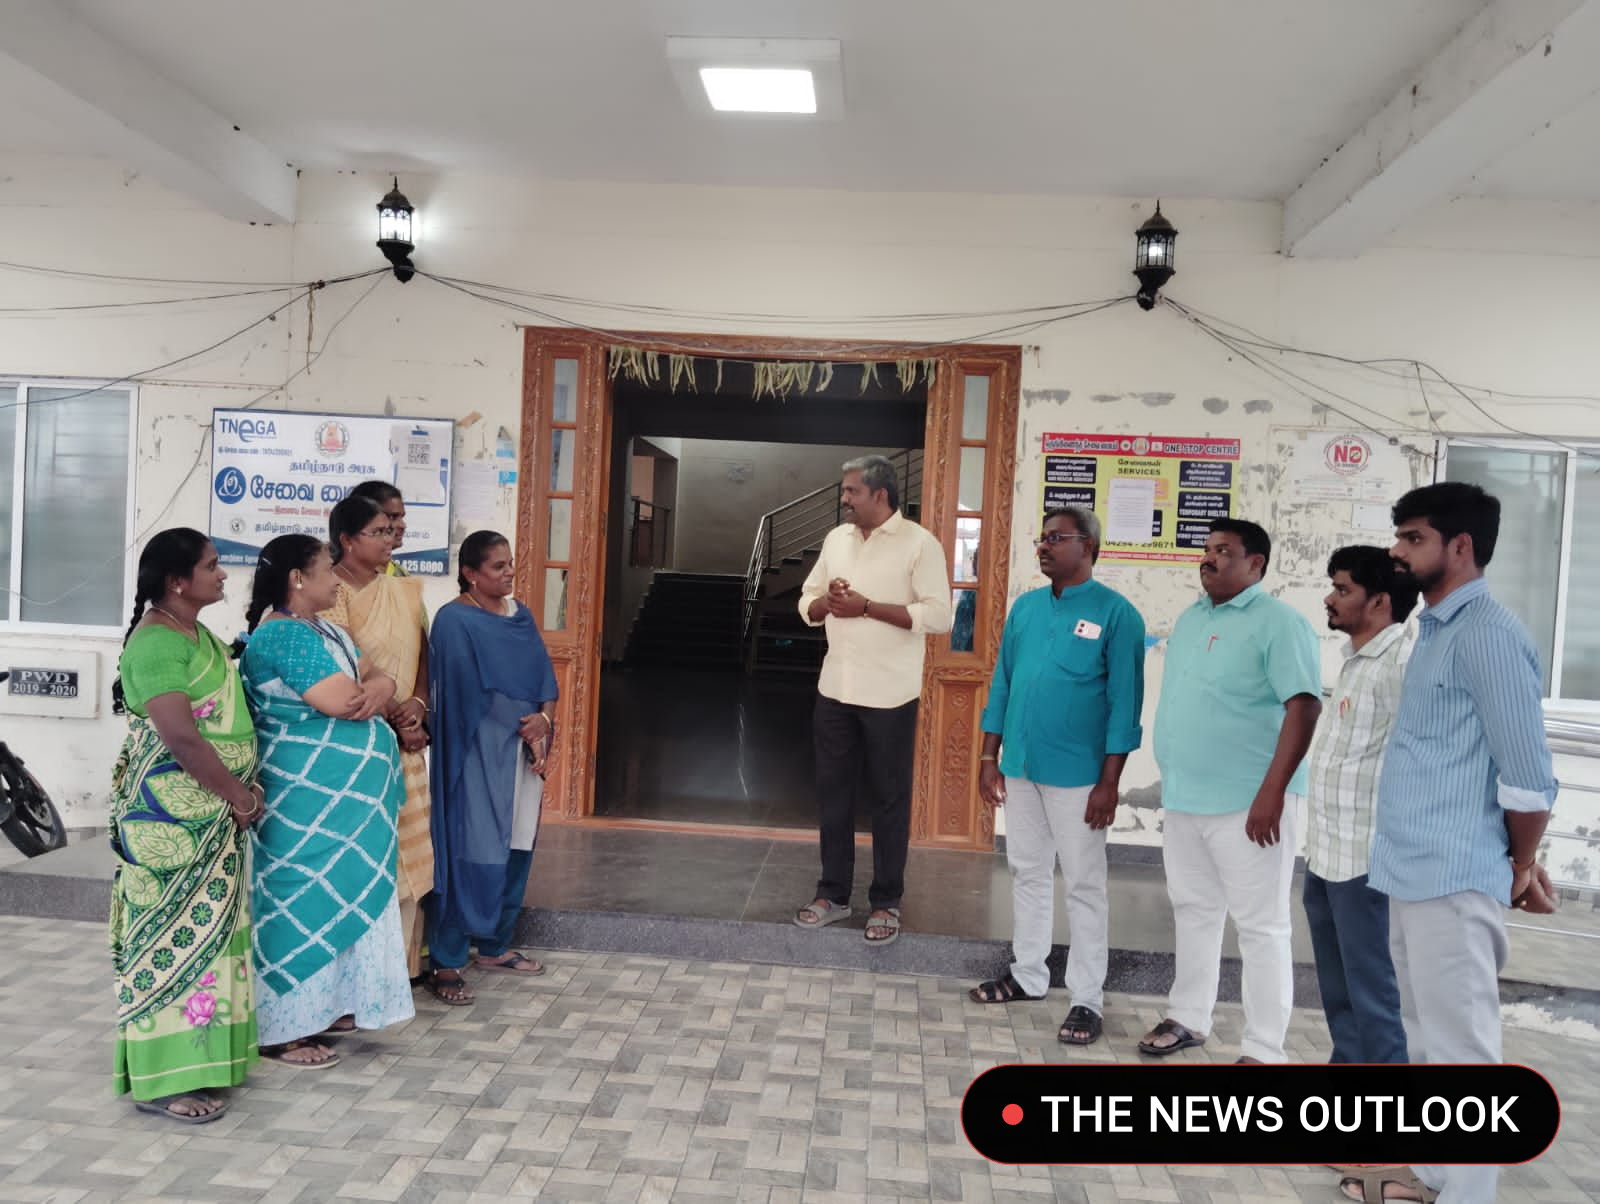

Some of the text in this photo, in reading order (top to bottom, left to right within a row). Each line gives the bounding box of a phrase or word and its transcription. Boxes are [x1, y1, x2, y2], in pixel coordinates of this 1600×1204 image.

[219, 418, 276, 443] TNeGA
[1164, 443, 1239, 456] ONE STOP CENTRE
[1334, 444, 1362, 463] NO
[1117, 467, 1161, 476] SERVICES
[250, 474, 314, 501] சேவை
[21, 671, 70, 683] PWD
[13, 683, 40, 694] 2019
[49, 684, 77, 696] 2020
